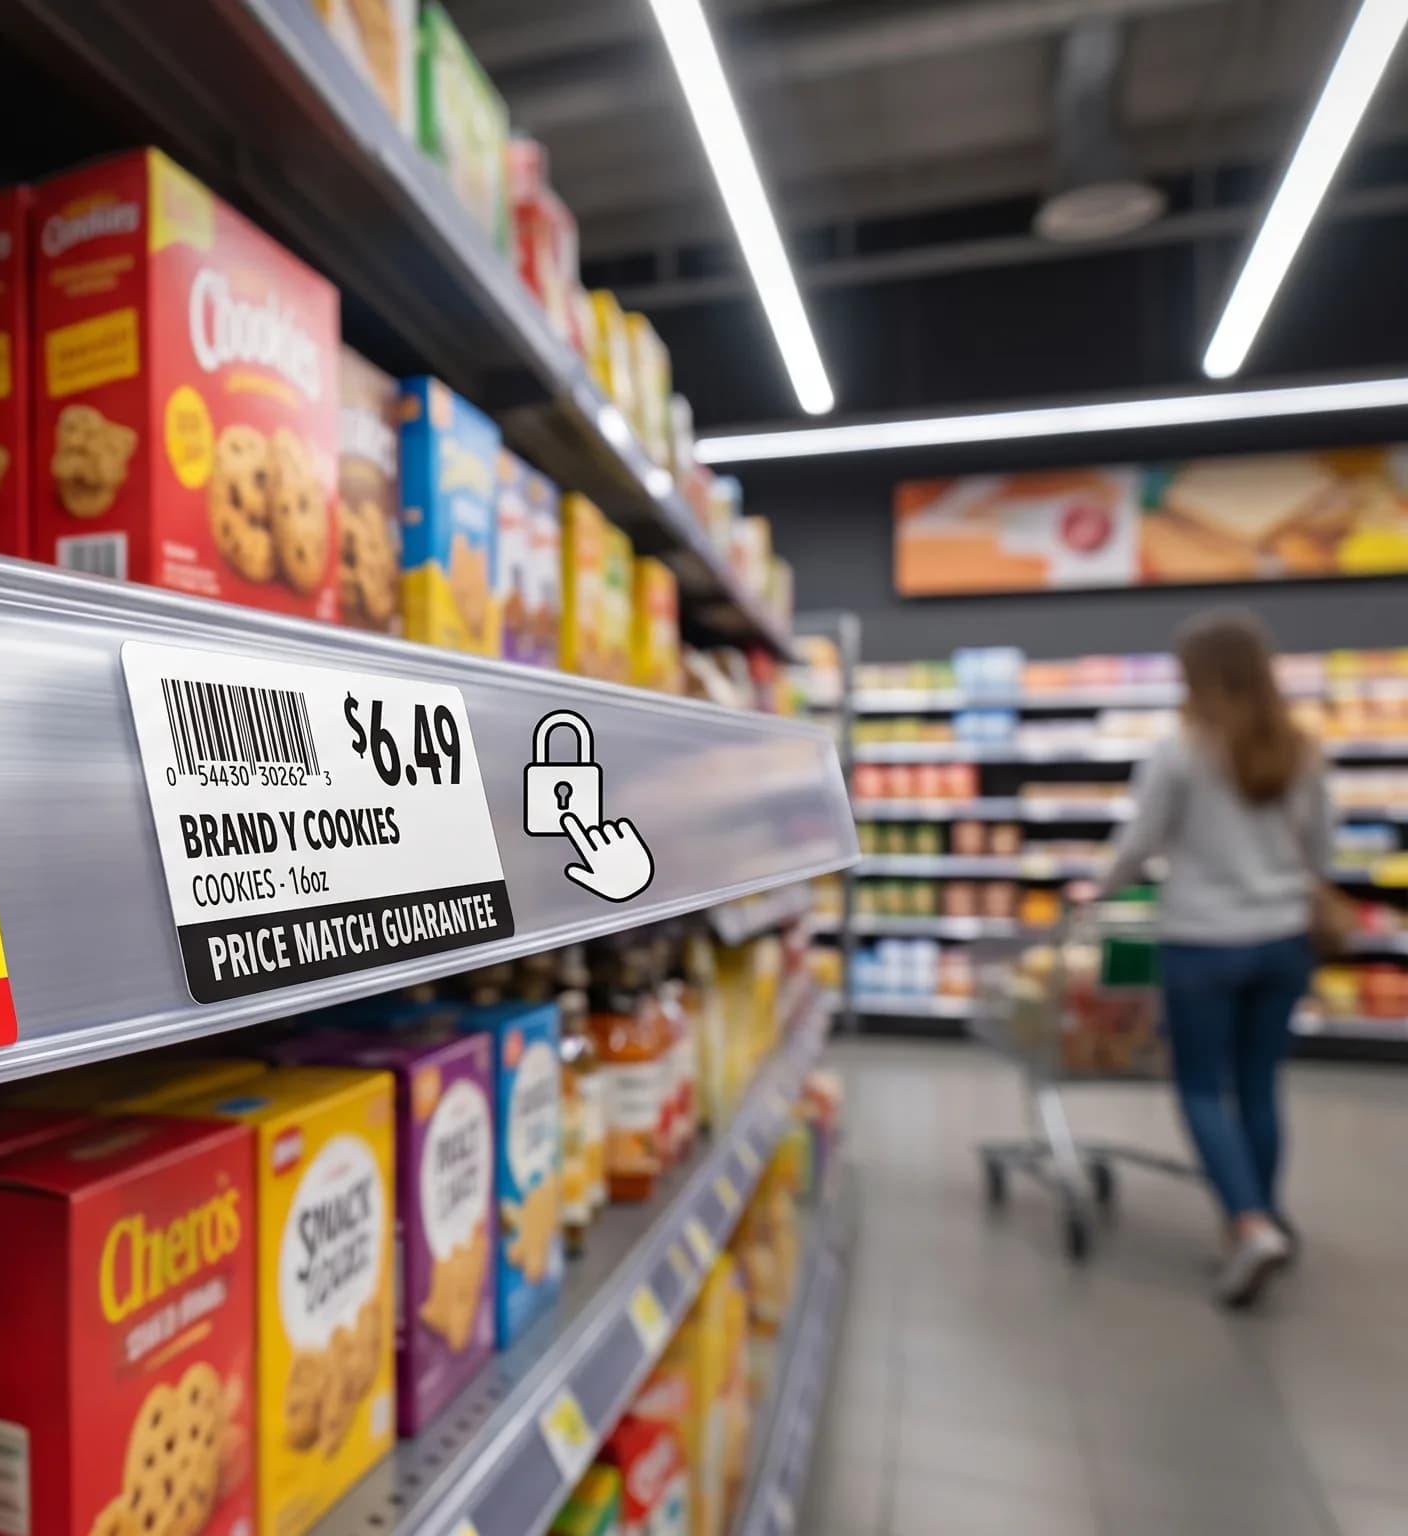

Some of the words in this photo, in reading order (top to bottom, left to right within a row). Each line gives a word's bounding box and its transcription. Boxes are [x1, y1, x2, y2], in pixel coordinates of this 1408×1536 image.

[343, 690, 461, 787] $6.49
[166, 766, 177, 787] 0
[197, 764, 250, 787] 54430
[258, 766, 308, 787] 30262
[323, 770, 332, 786] 3
[179, 812, 278, 859] BRAND
[278, 811, 297, 852] Y
[303, 806, 401, 851] COOKIES
[192, 868, 276, 908] COOKIES
[288, 865, 330, 895] 16oz
[207, 921, 291, 982] PRICE
[292, 912, 379, 966] MATCH
[381, 893, 498, 949] GUARANTEE
